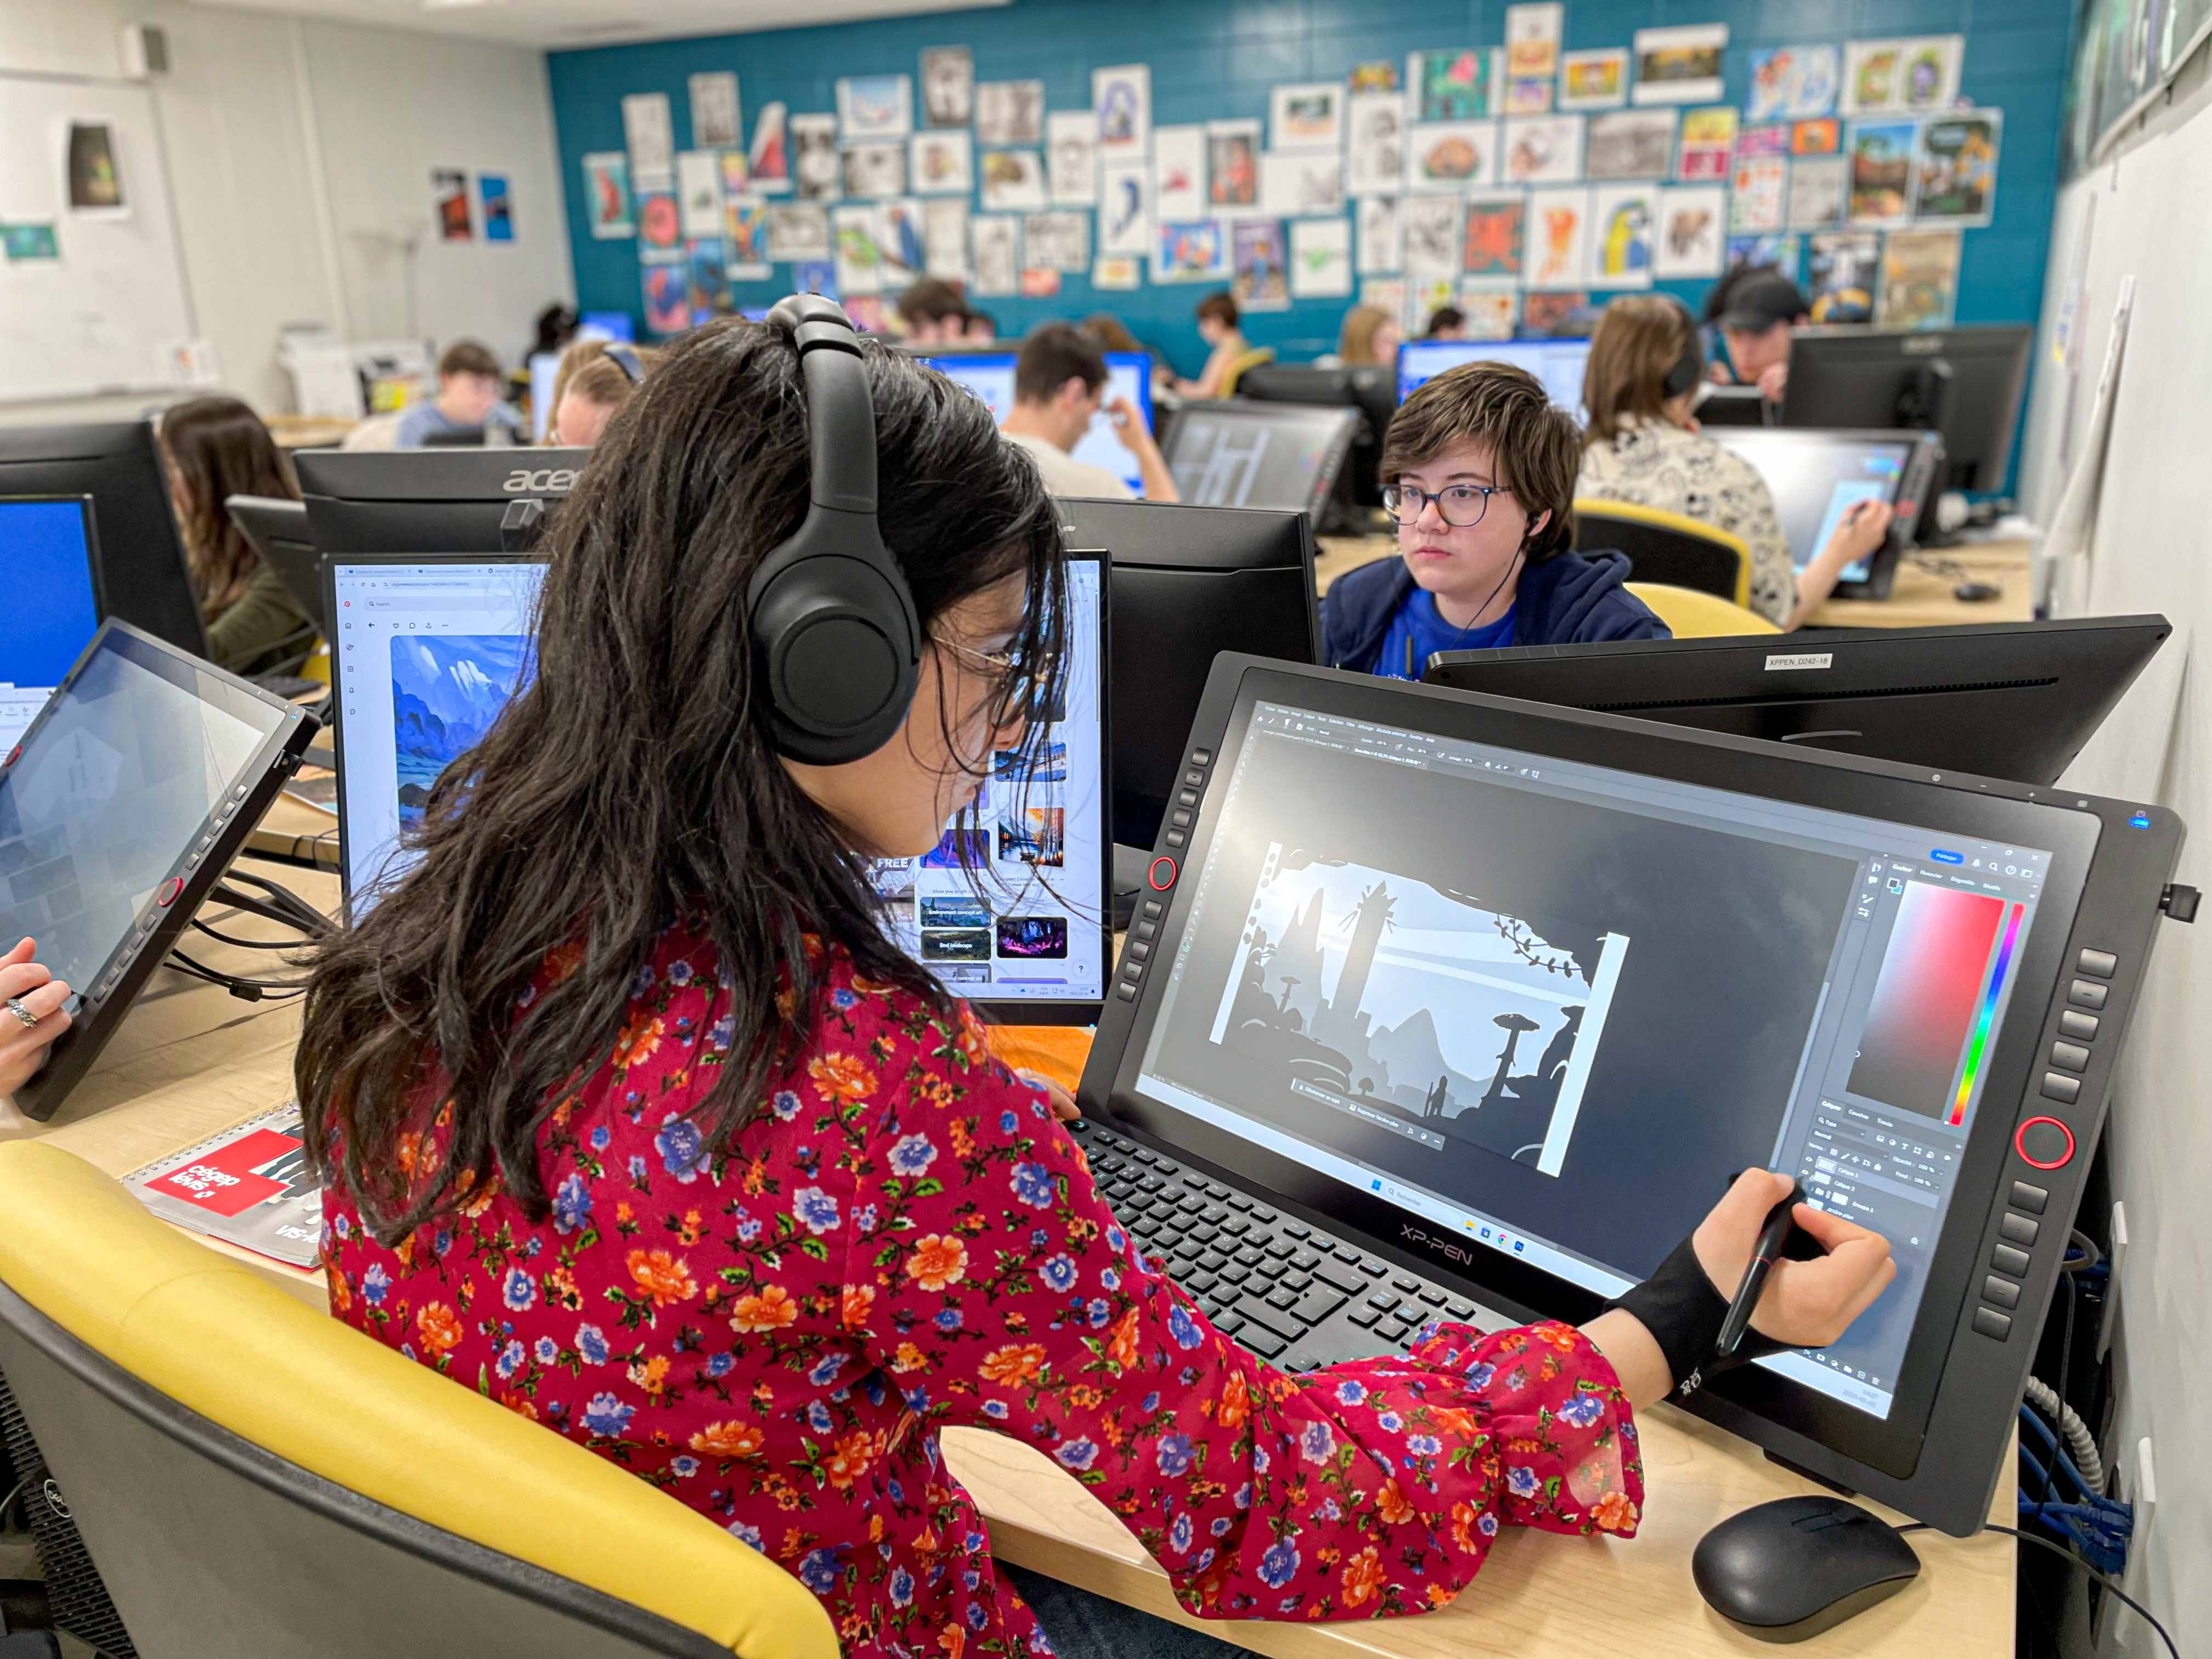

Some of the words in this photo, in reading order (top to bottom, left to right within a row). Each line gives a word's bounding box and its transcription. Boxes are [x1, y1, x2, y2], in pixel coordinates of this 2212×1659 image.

[1769, 658, 1828, 666] XPPEN_D242-18
[877, 858, 909, 868] FREE
[1848, 1109, 1869, 1120] Couches
[1825, 1120, 1837, 1128] Type
[1814, 1131, 1832, 1141] Normal
[188, 1165, 241, 1187] cégep
[1400, 1224, 1472, 1266] XP-PEN
